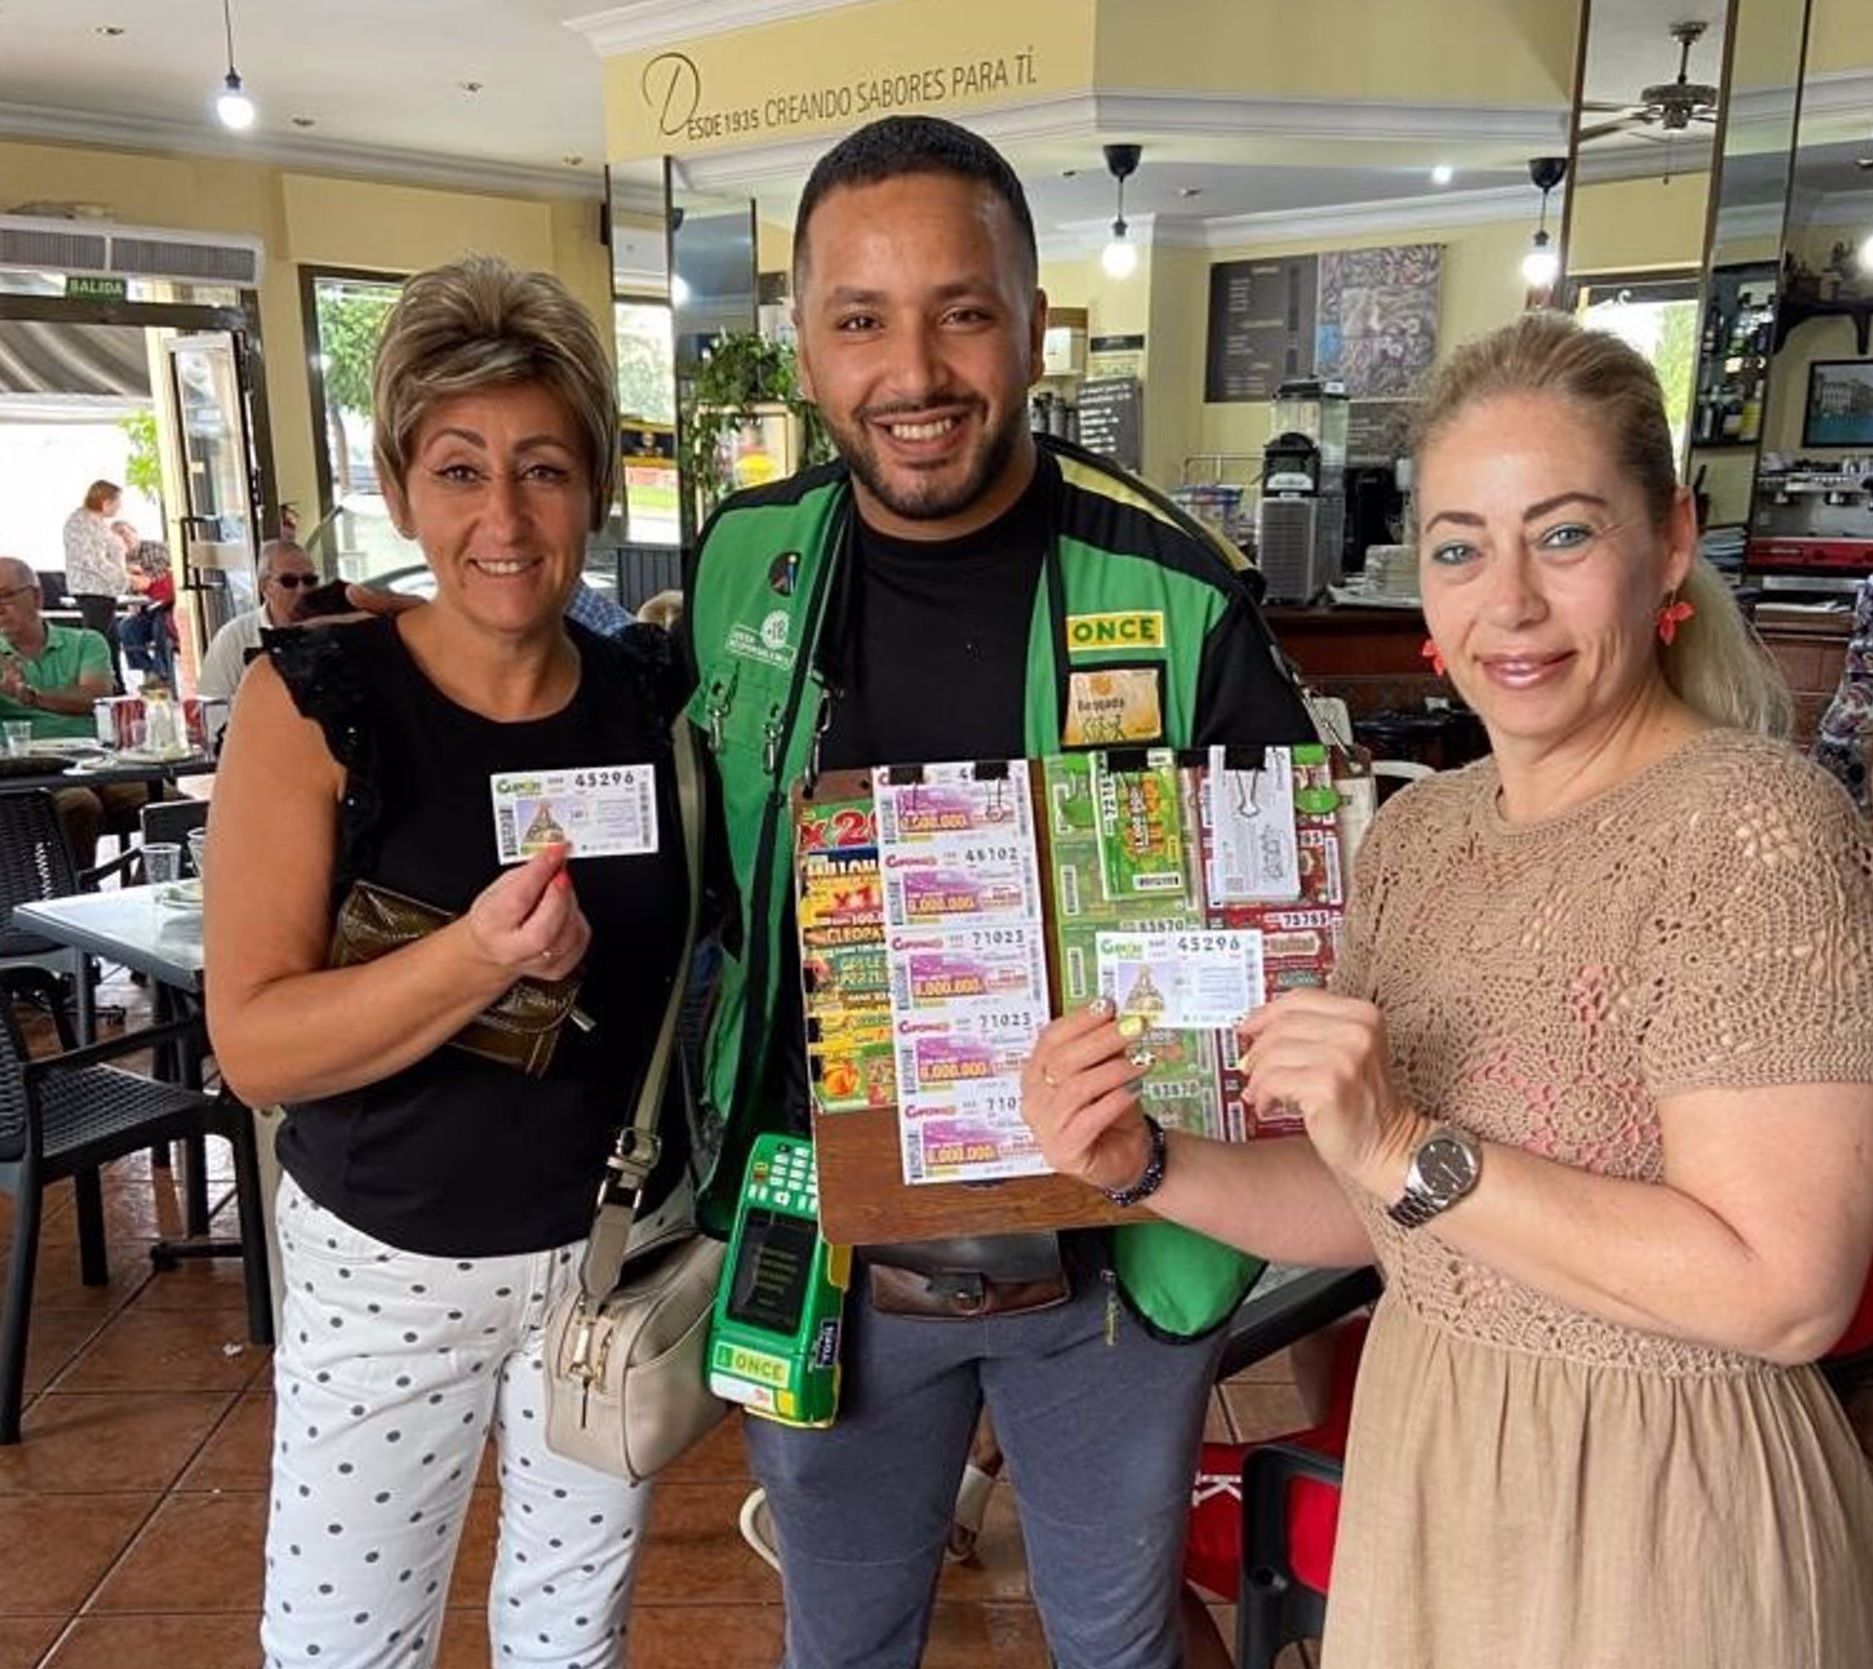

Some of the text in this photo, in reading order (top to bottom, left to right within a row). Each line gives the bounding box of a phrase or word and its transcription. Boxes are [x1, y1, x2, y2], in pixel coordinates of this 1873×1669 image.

[725, 112, 761, 134] 1935
[764, 87, 851, 126] CREANDO
[857, 69, 946, 113] SABORES
[952, 57, 1008, 97] PARA
[70, 278, 123, 295] SALIDA
[1073, 619, 1155, 642] ONCE
[575, 772, 635, 788] 45296
[1178, 936, 1241, 952] 45296
[980, 1012, 1032, 1028] 71023
[987, 1096, 1016, 1111] 710
[735, 1354, 785, 1381] ONCE
